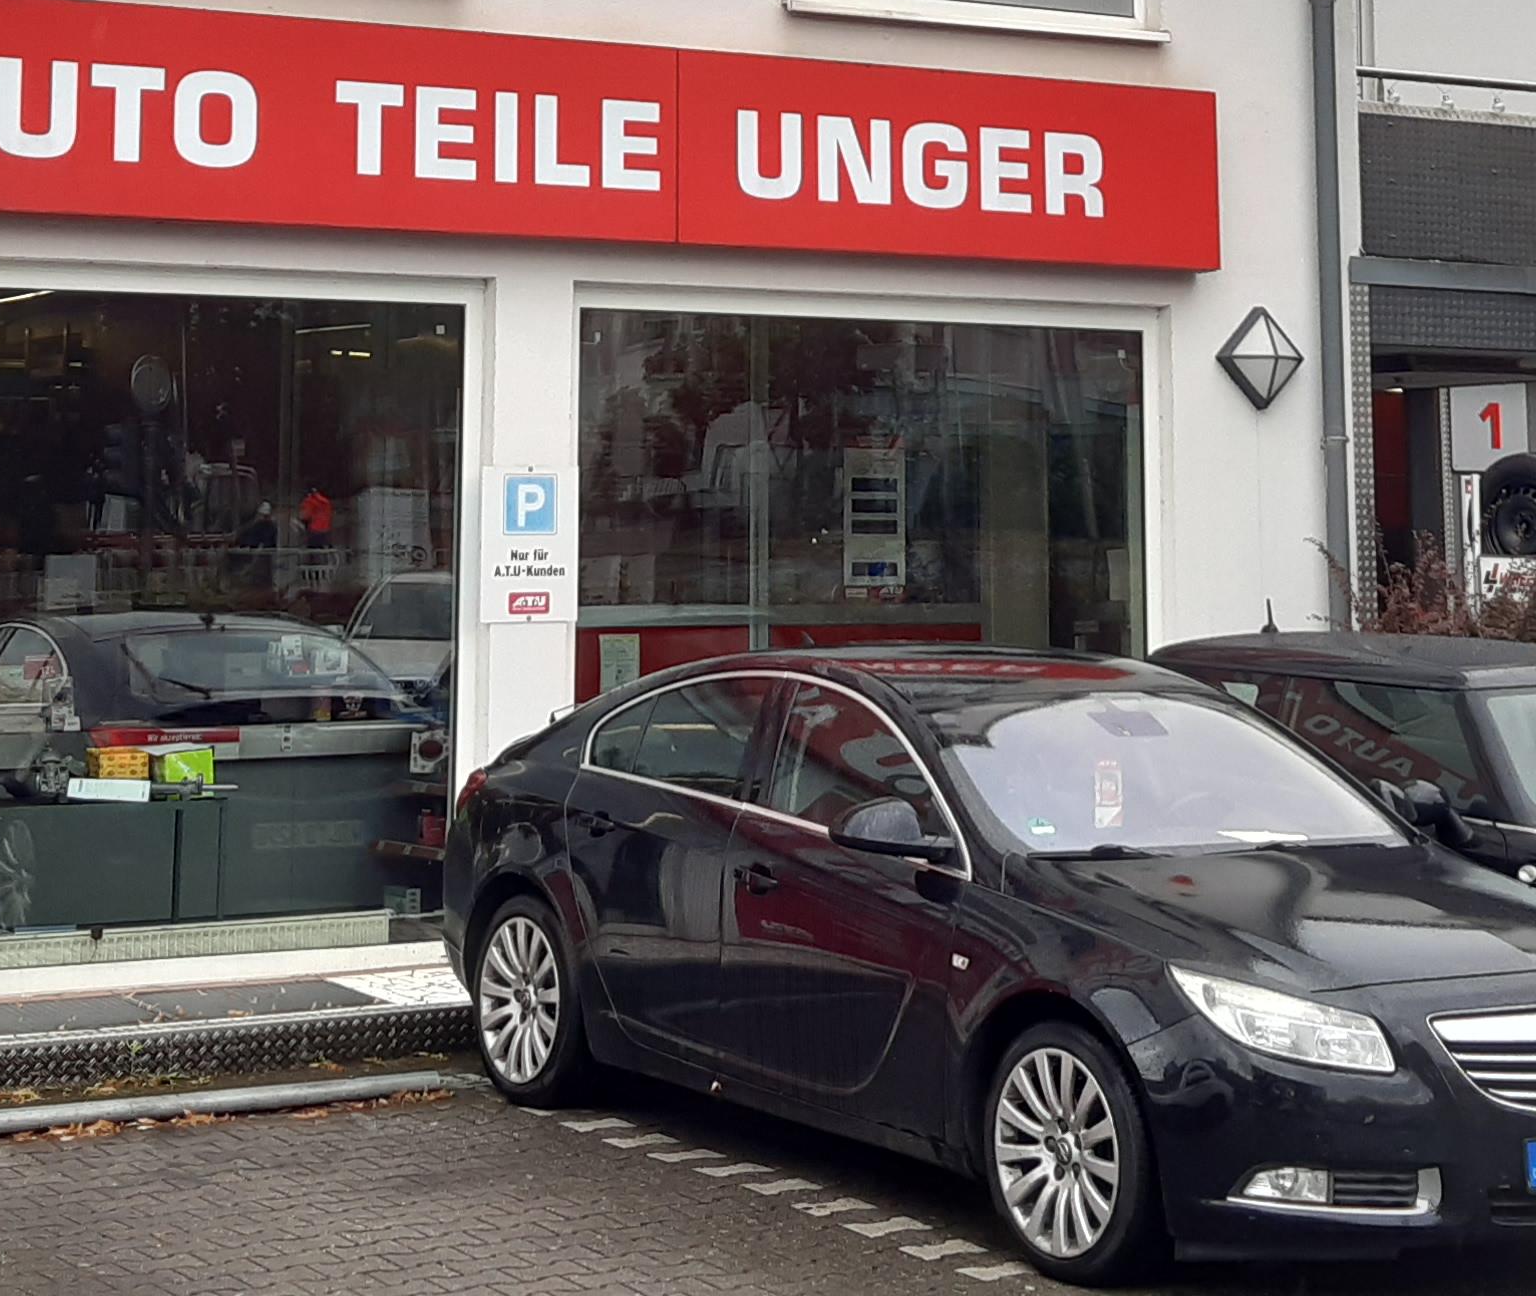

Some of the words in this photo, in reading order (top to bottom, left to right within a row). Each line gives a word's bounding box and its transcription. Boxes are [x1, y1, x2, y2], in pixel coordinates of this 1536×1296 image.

[335, 80, 662, 192] TEILE
[736, 109, 1107, 218] UNGER
[1479, 402, 1503, 450] 1
[517, 483, 545, 527] P
[494, 565, 565, 577] A.T.U-Kunden
[510, 549, 529, 561] Nur
[533, 548, 549, 561] für
